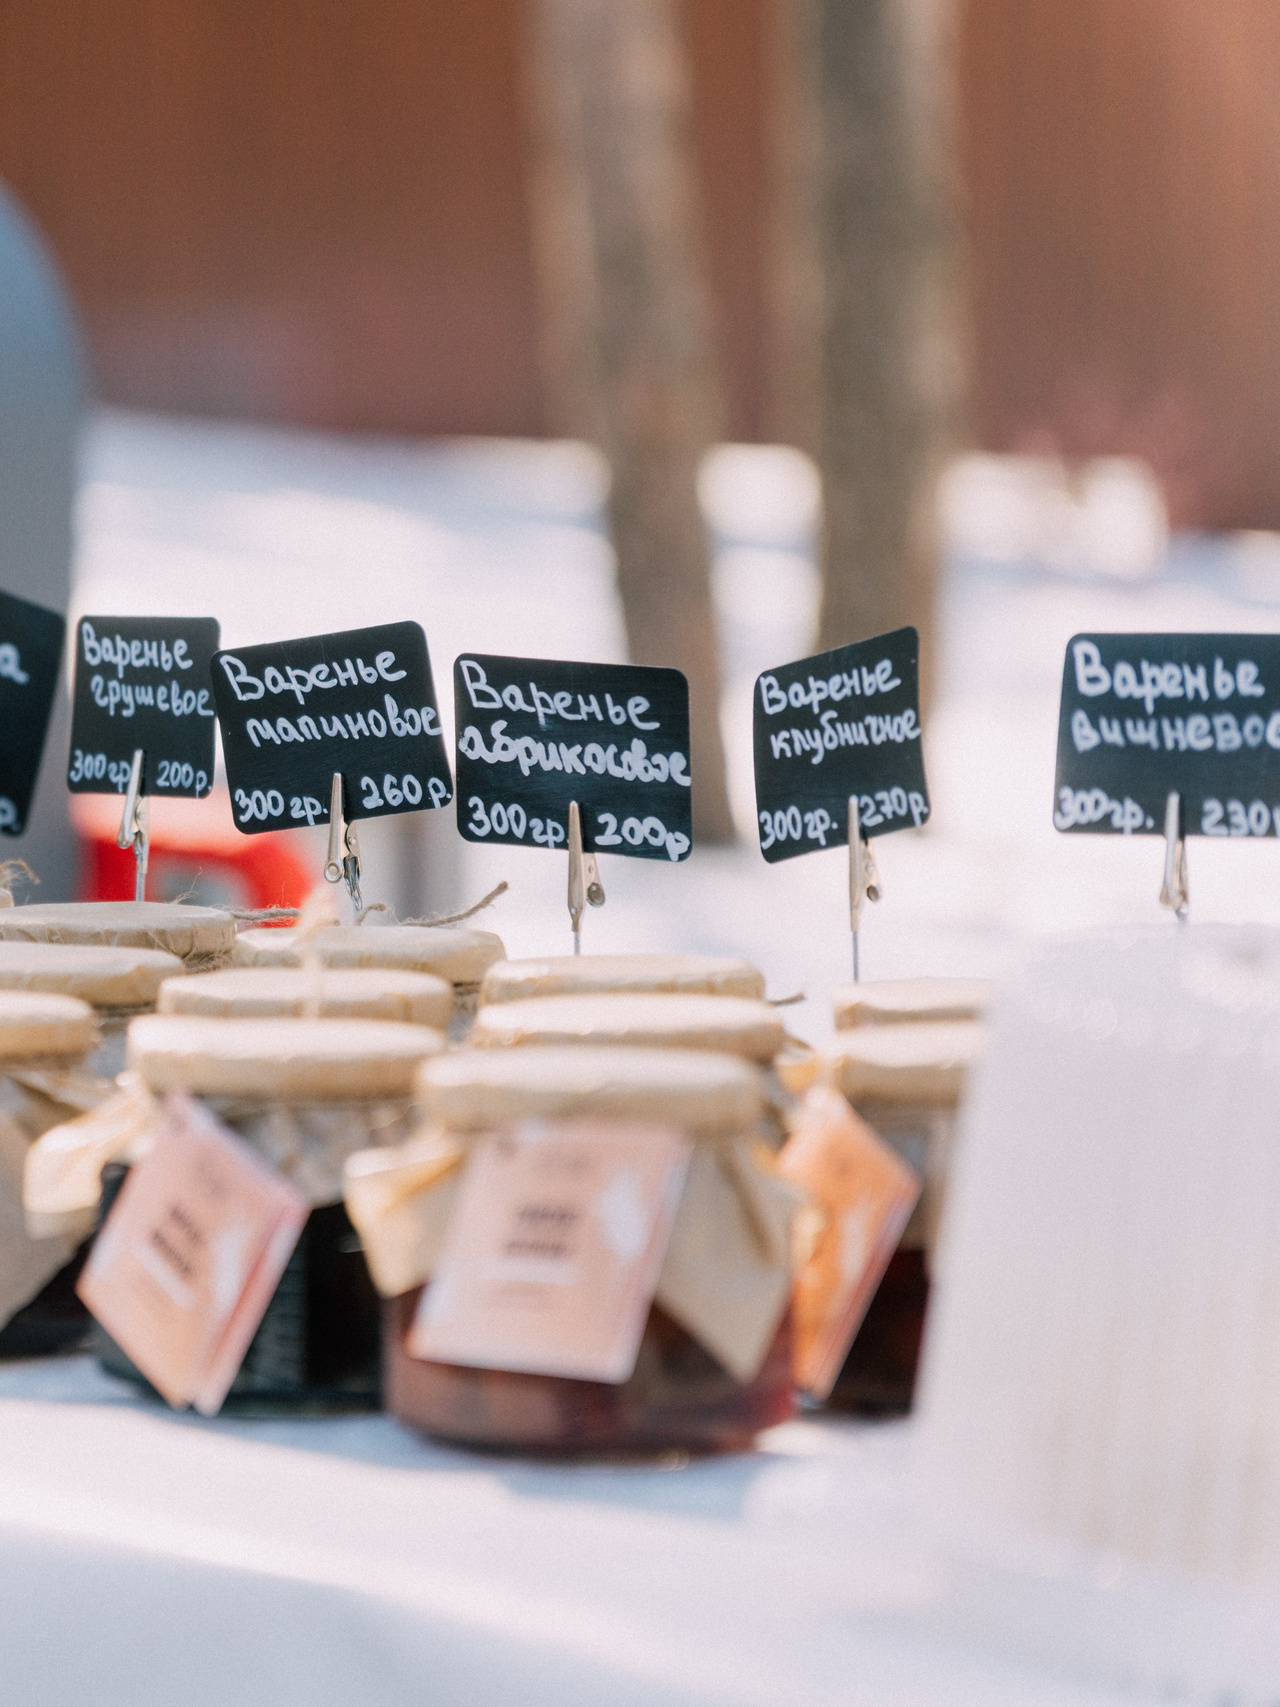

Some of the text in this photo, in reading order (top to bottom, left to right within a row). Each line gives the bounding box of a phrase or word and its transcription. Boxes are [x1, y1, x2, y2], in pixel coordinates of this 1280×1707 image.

[82, 622, 194, 679] Варенье
[220, 651, 407, 705] Варенье
[1072, 639, 1266, 716] Варенье
[91, 674, 215, 718] грушевое
[460, 660, 661, 730] Варенье
[760, 659, 902, 715] Варенье
[247, 694, 443, 748] малиновое
[771, 708, 922, 766] клубничное
[458, 720, 692, 787] абрикосовое
